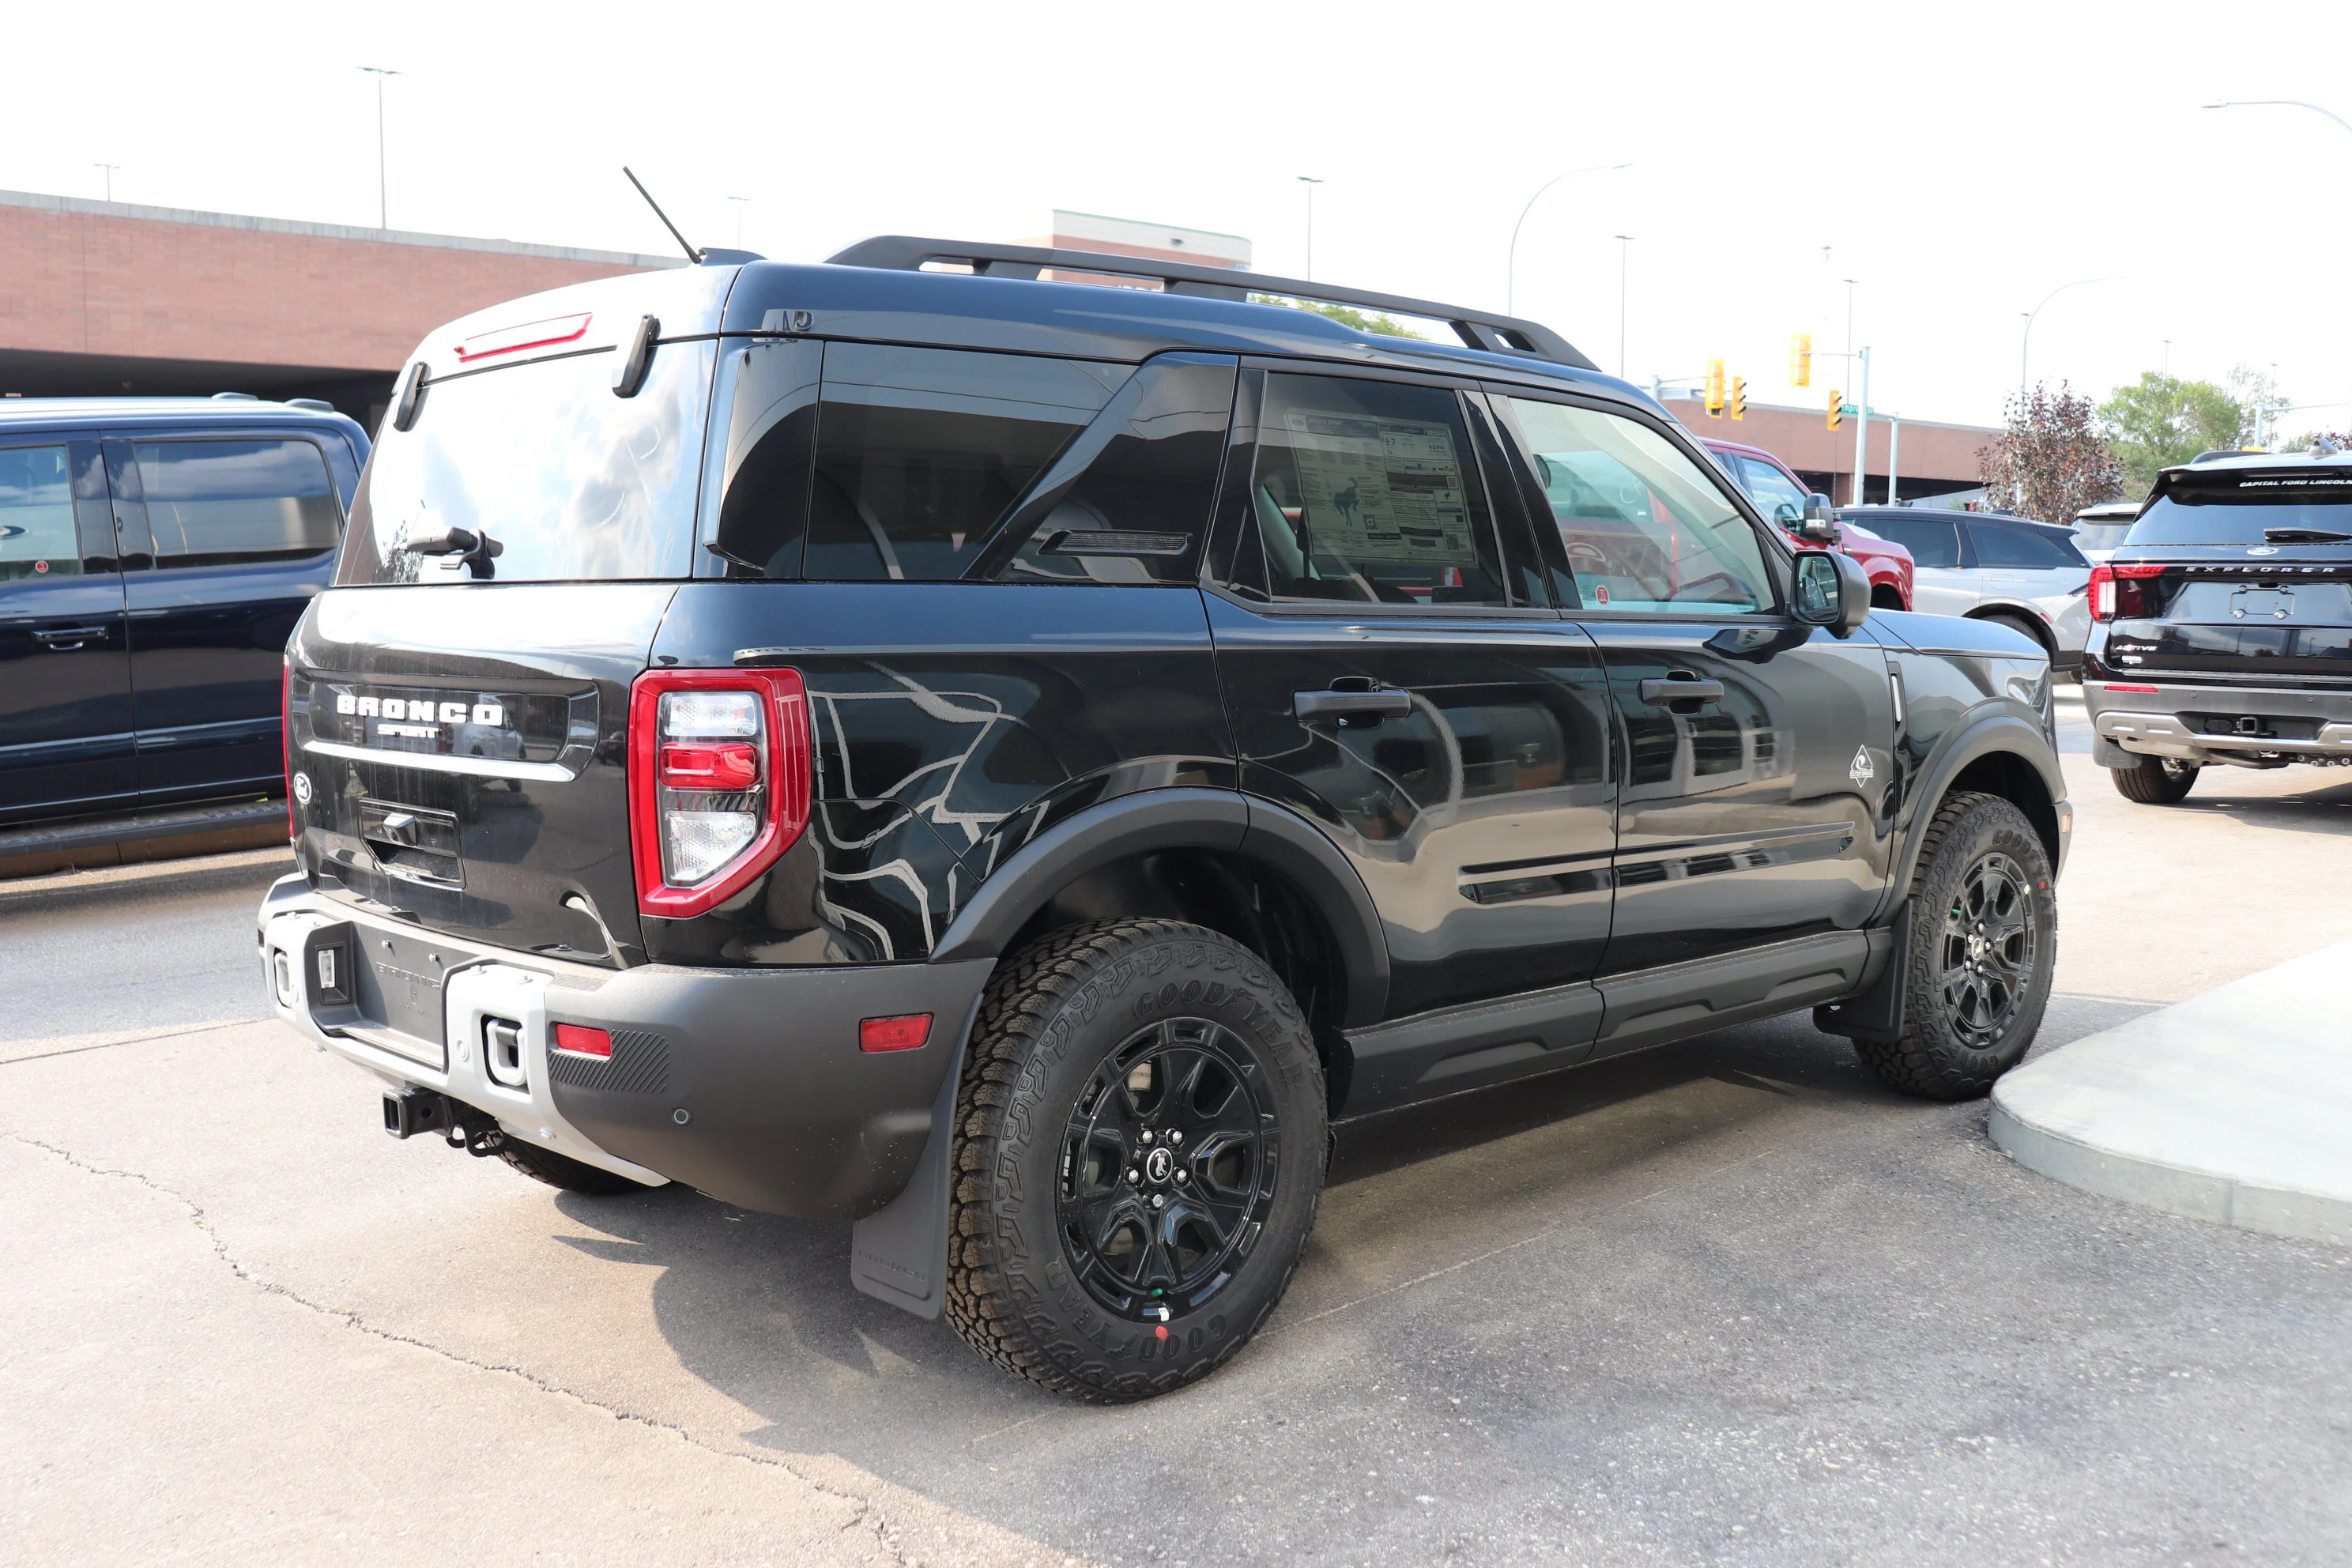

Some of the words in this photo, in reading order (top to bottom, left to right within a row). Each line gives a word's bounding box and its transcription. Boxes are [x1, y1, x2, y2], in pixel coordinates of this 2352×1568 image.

[337, 695, 503, 726] BRONCO
[378, 724, 439, 738] SPORT
[376, 962, 441, 989] BRONC
[1134, 980, 1306, 1091] GOODYEAR
